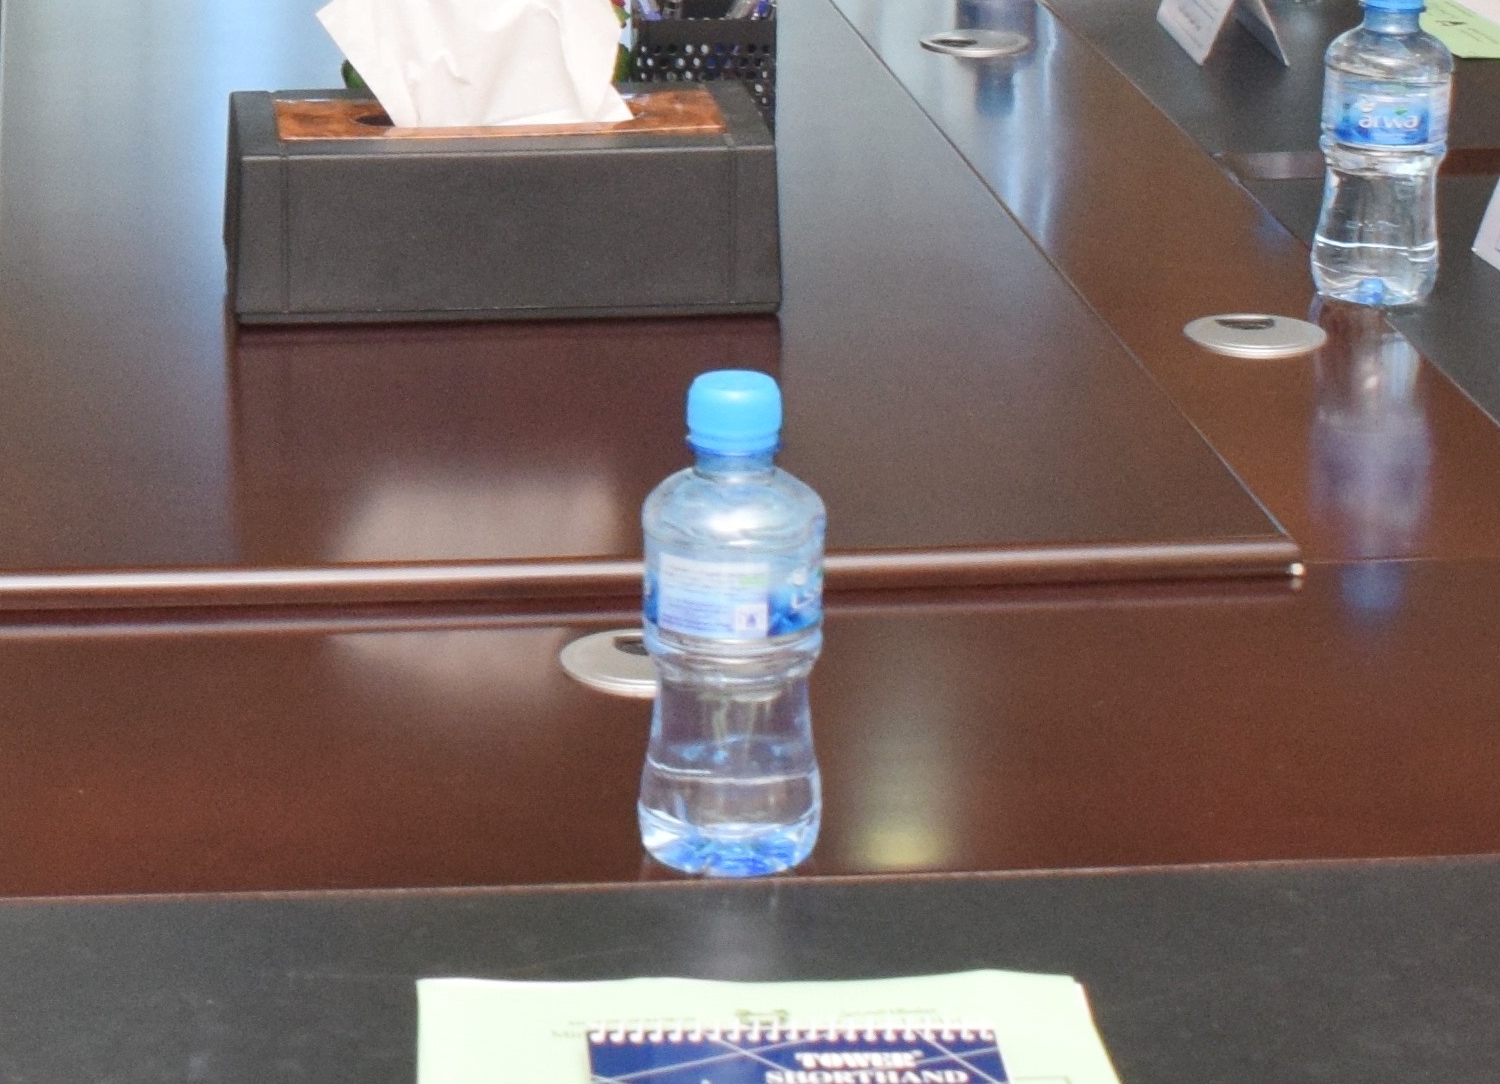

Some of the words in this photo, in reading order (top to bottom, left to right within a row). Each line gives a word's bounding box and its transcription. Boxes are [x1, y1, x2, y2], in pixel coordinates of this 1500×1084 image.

[1358, 115, 1419, 128] arwa
[795, 1051, 915, 1069] TOWER
[764, 1069, 968, 1084] SHORTHAND
